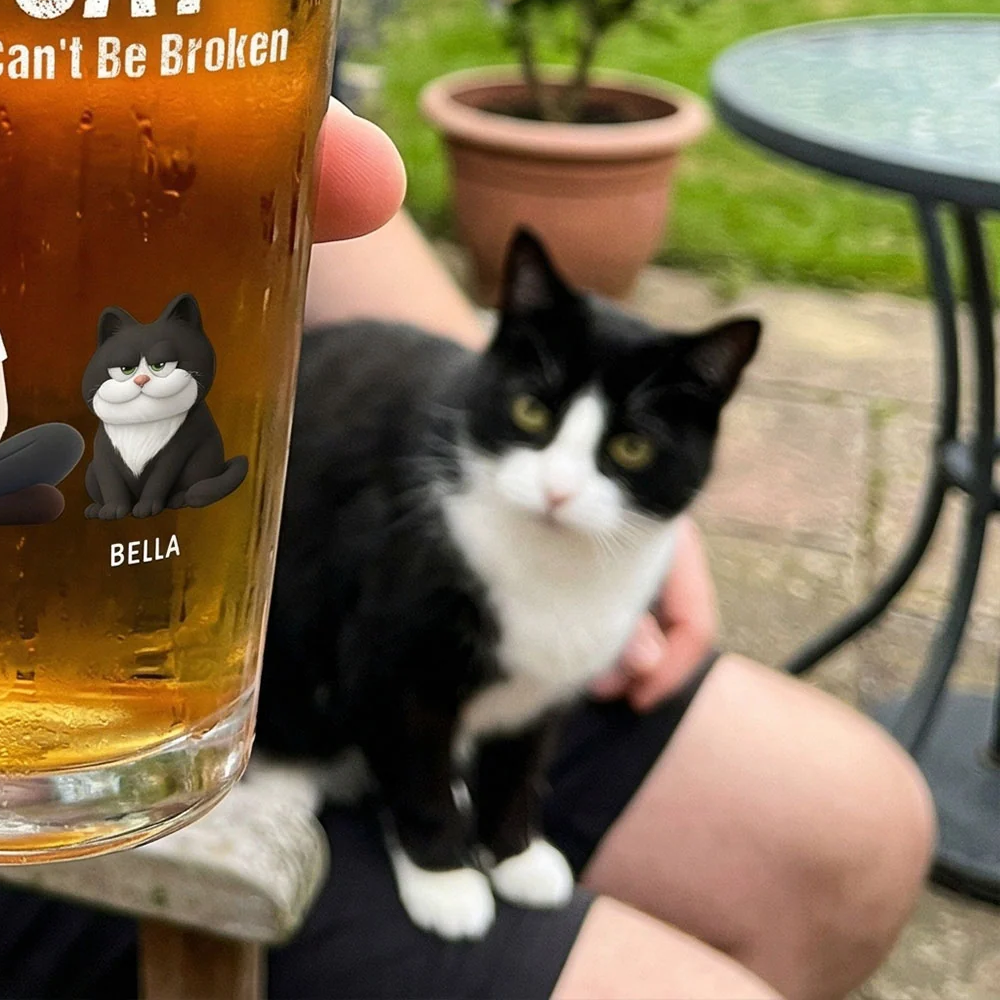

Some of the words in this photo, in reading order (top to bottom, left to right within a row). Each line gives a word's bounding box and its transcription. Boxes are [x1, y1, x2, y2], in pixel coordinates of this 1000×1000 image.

[97, 36, 147, 79] Be
[160, 28, 289, 76] Broken
[110, 534, 180, 567] BELLA
